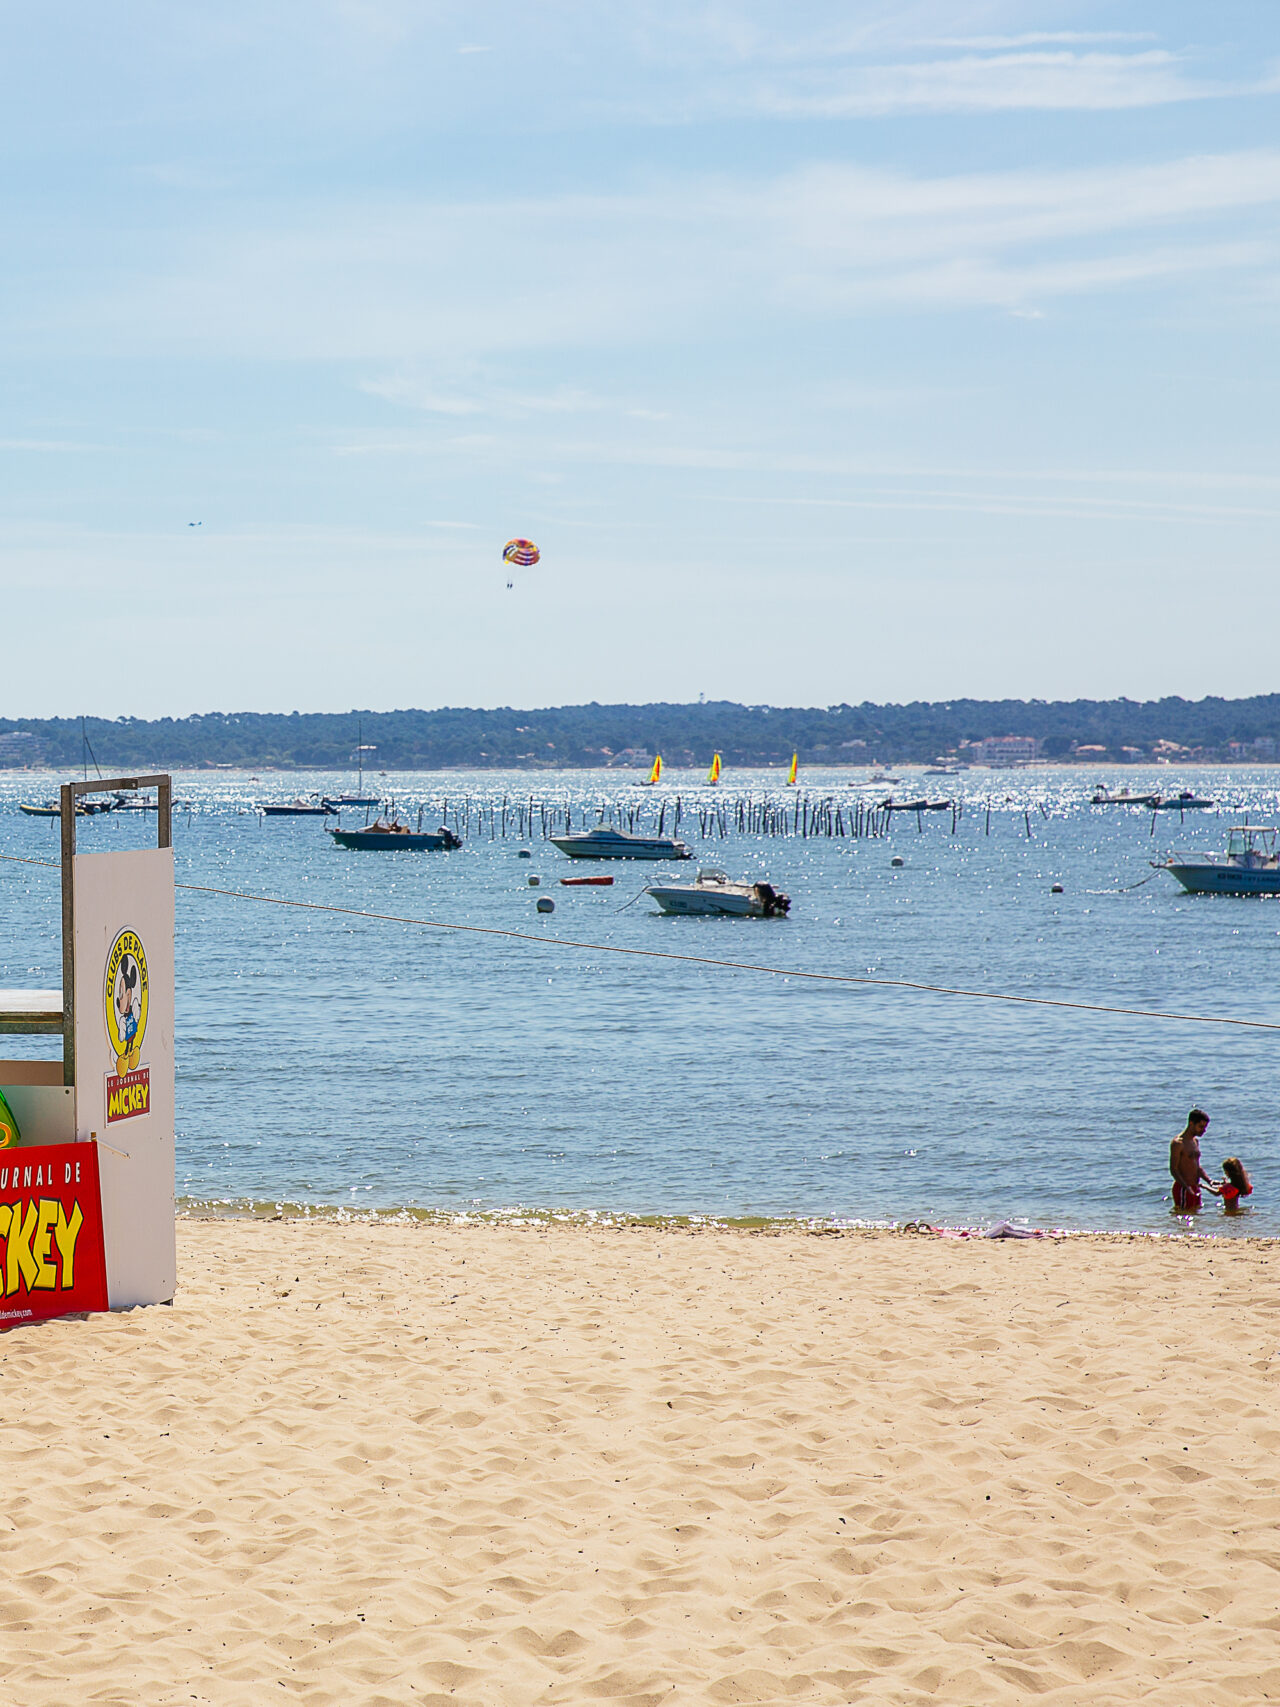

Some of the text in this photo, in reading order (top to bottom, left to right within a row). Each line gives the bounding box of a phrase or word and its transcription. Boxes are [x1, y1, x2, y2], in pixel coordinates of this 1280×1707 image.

[107, 935, 148, 998] CLUBS DE PLAGE
[107, 1080, 114, 1088] LE
[116, 1074, 140, 1086] JOURNAL
[108, 1083, 148, 1118] MICKEY
[65, 1162, 81, 1184] DE
